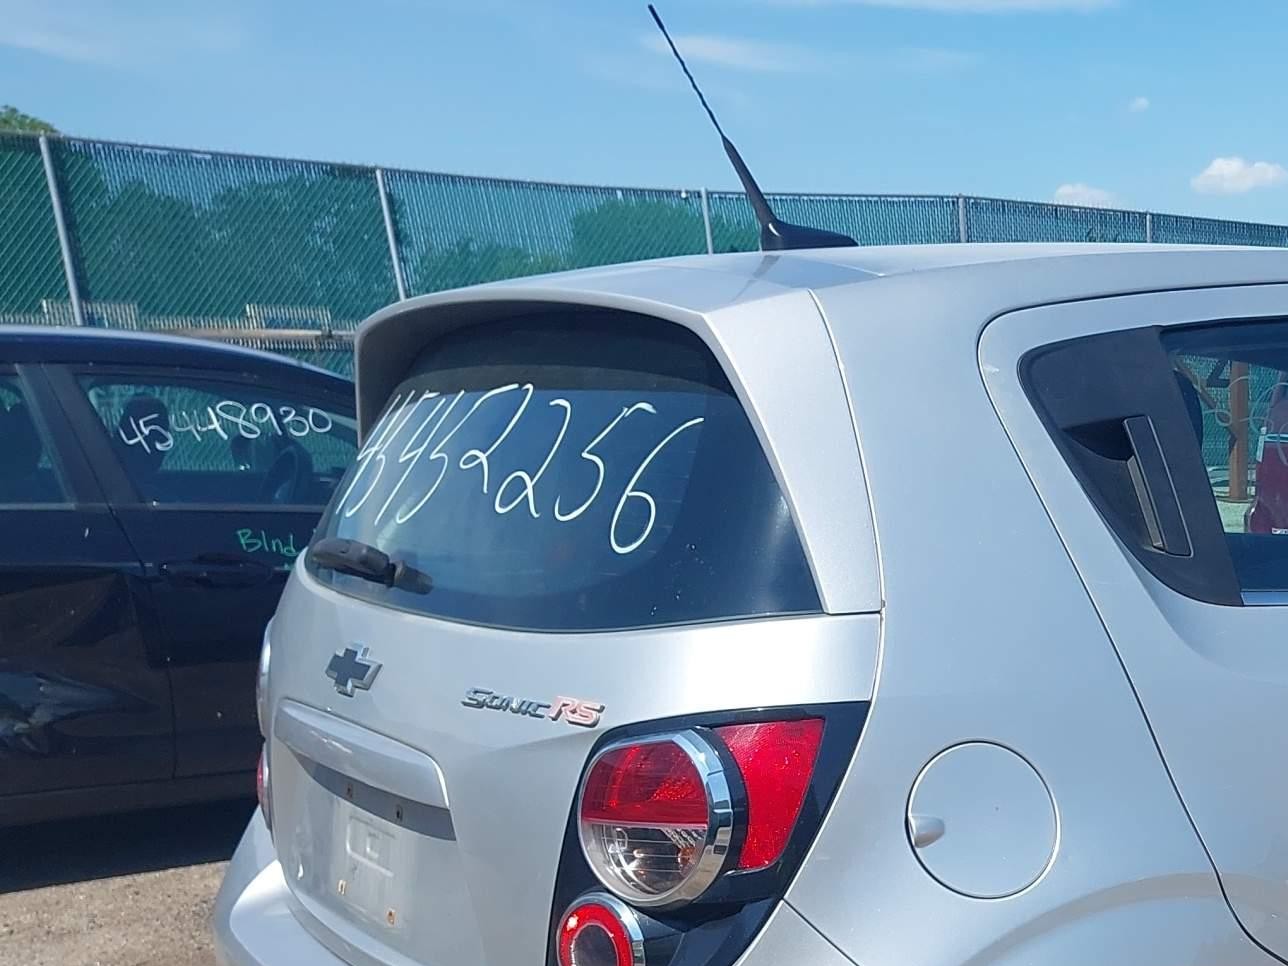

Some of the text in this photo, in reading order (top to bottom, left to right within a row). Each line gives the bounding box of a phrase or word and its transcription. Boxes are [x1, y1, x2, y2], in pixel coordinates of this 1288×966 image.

[119, 400, 333, 454] 45448930
[336, 383, 705, 554] 45452256
[549, 695, 606, 728] RS
